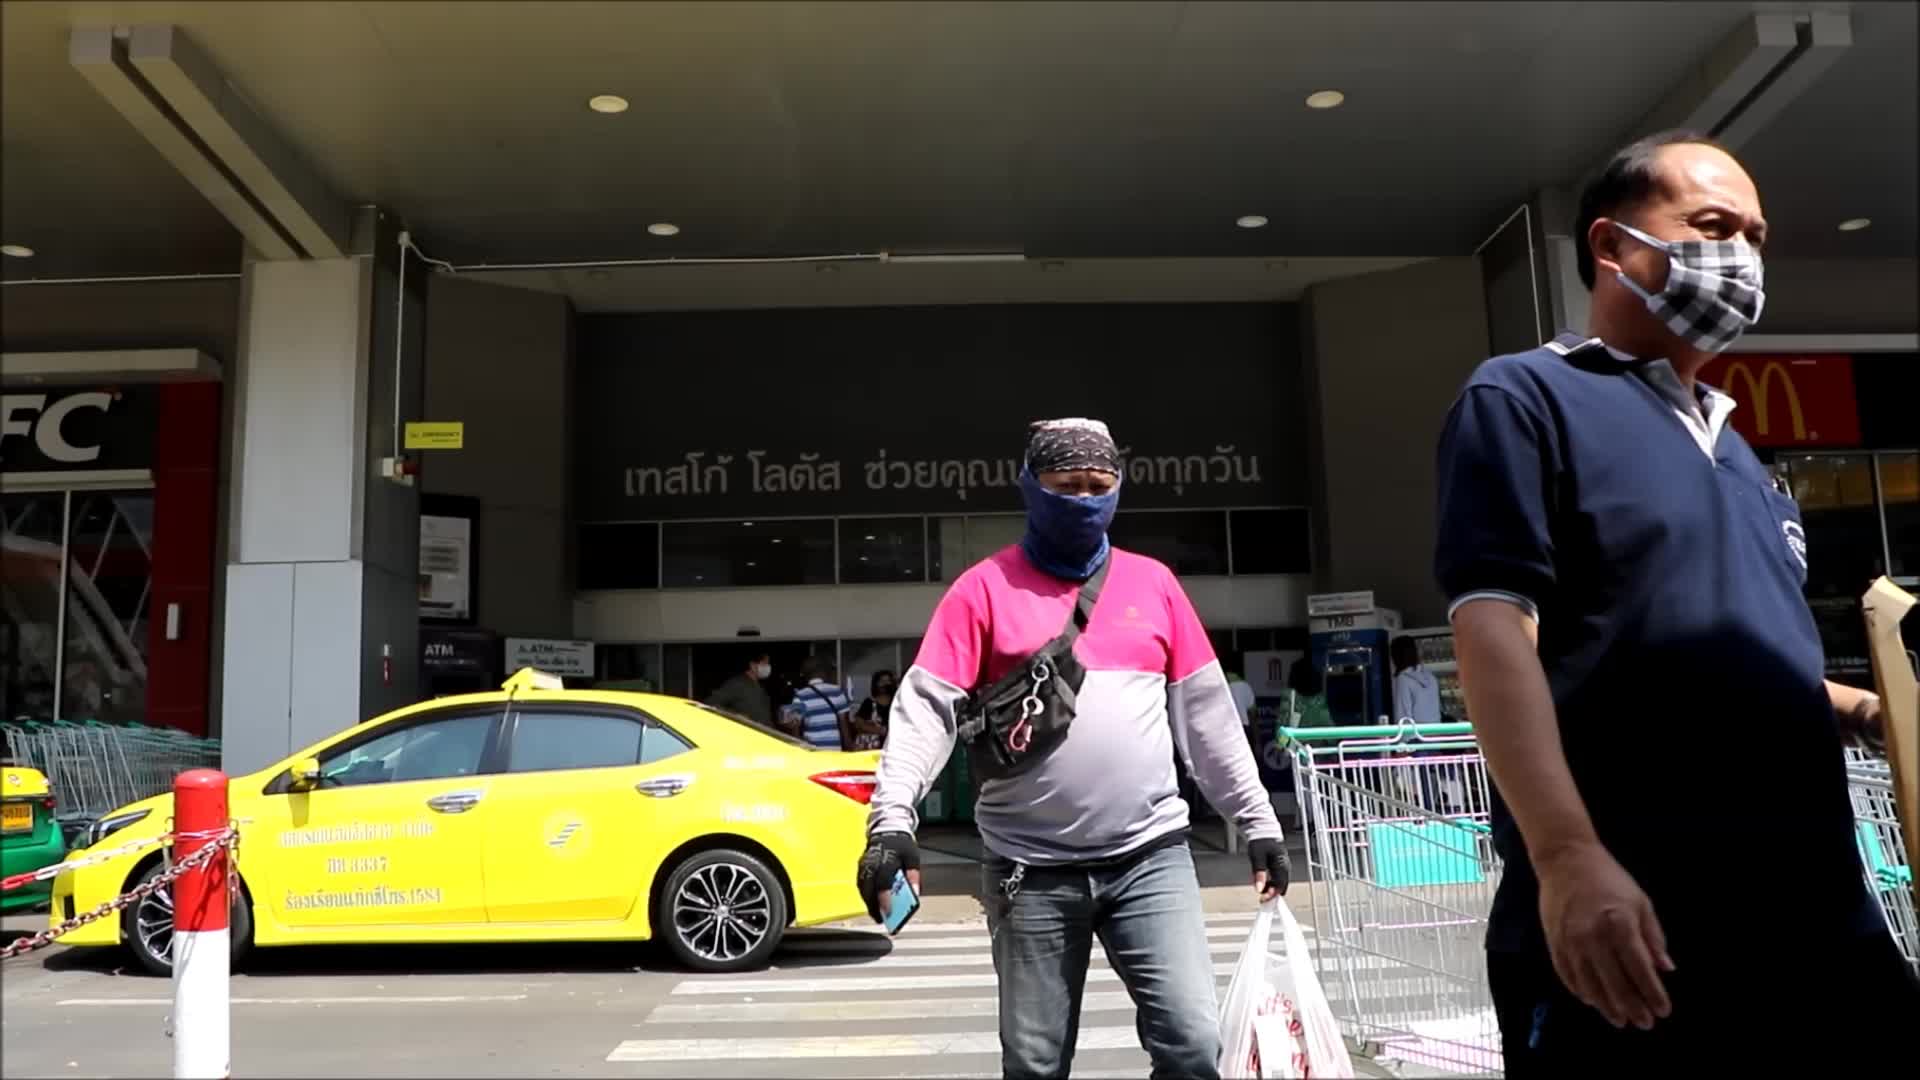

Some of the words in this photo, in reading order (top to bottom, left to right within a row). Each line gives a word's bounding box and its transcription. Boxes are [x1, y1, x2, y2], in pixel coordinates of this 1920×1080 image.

[624, 451, 733, 497] เทสโก้
[746, 449, 841, 493] โลตัส
[424, 644, 454, 657] ATM
